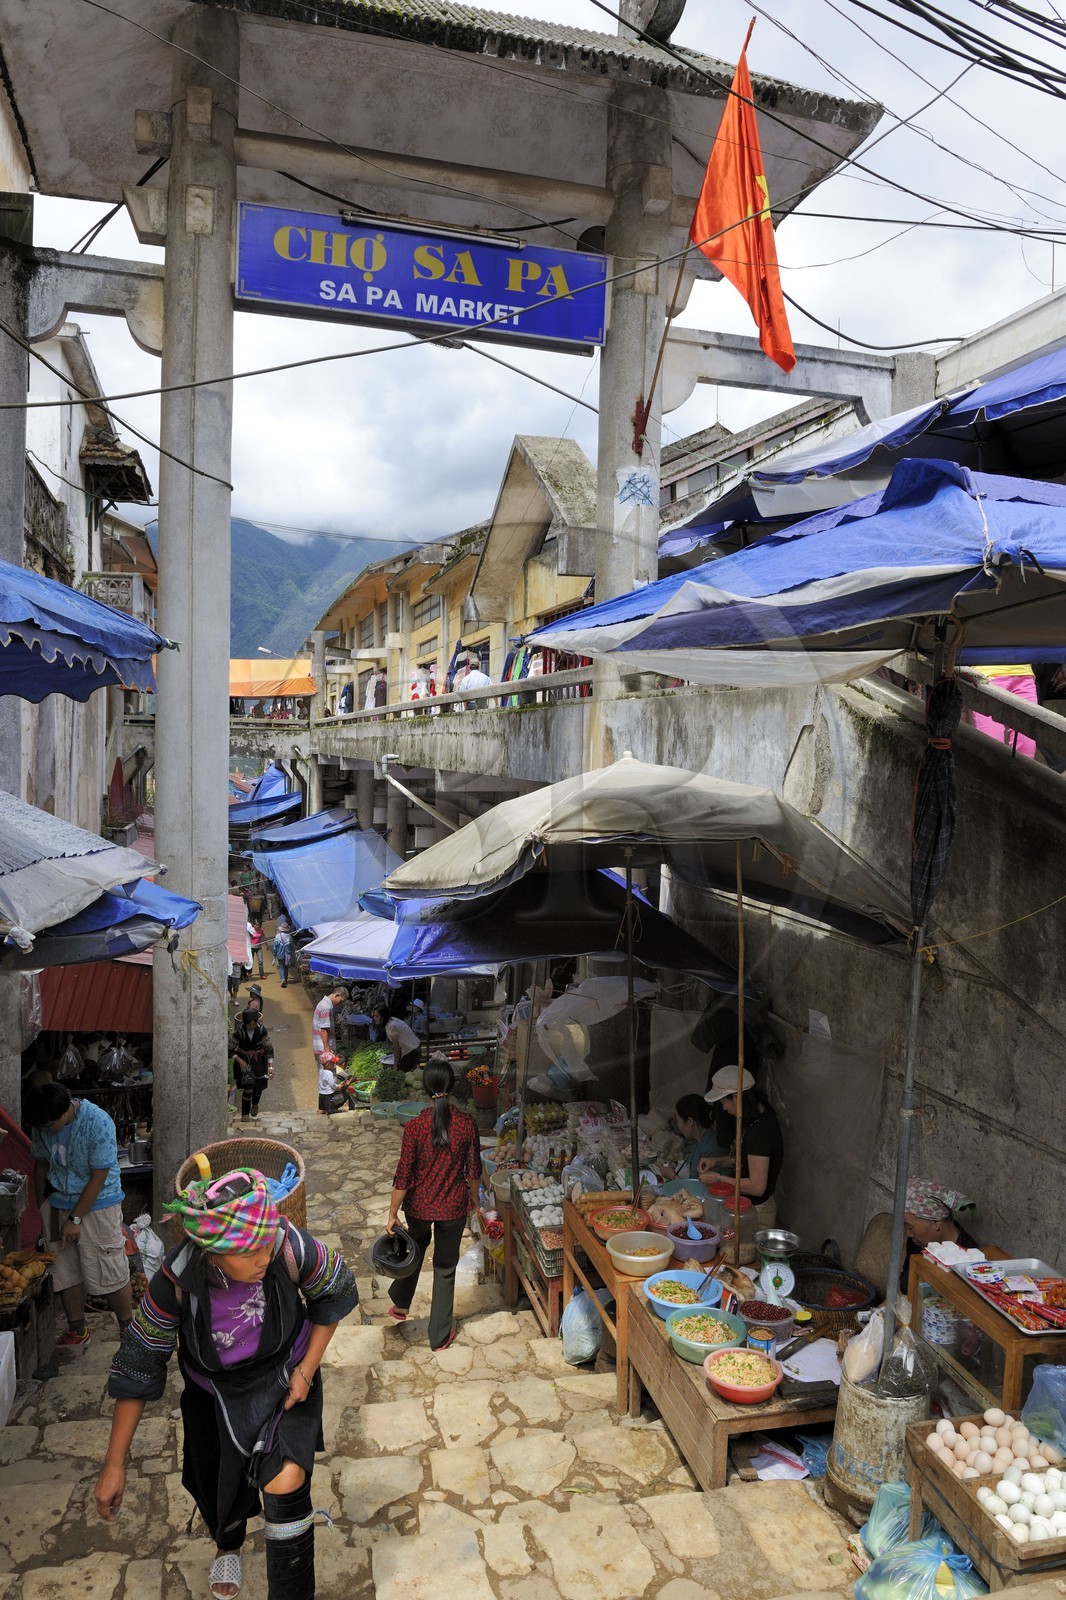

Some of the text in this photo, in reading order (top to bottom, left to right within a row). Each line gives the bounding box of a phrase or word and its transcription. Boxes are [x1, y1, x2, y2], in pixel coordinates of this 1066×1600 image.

[272, 225, 575, 300] CHỢ SA PA
[318, 279, 523, 327] SA PA MARKET
